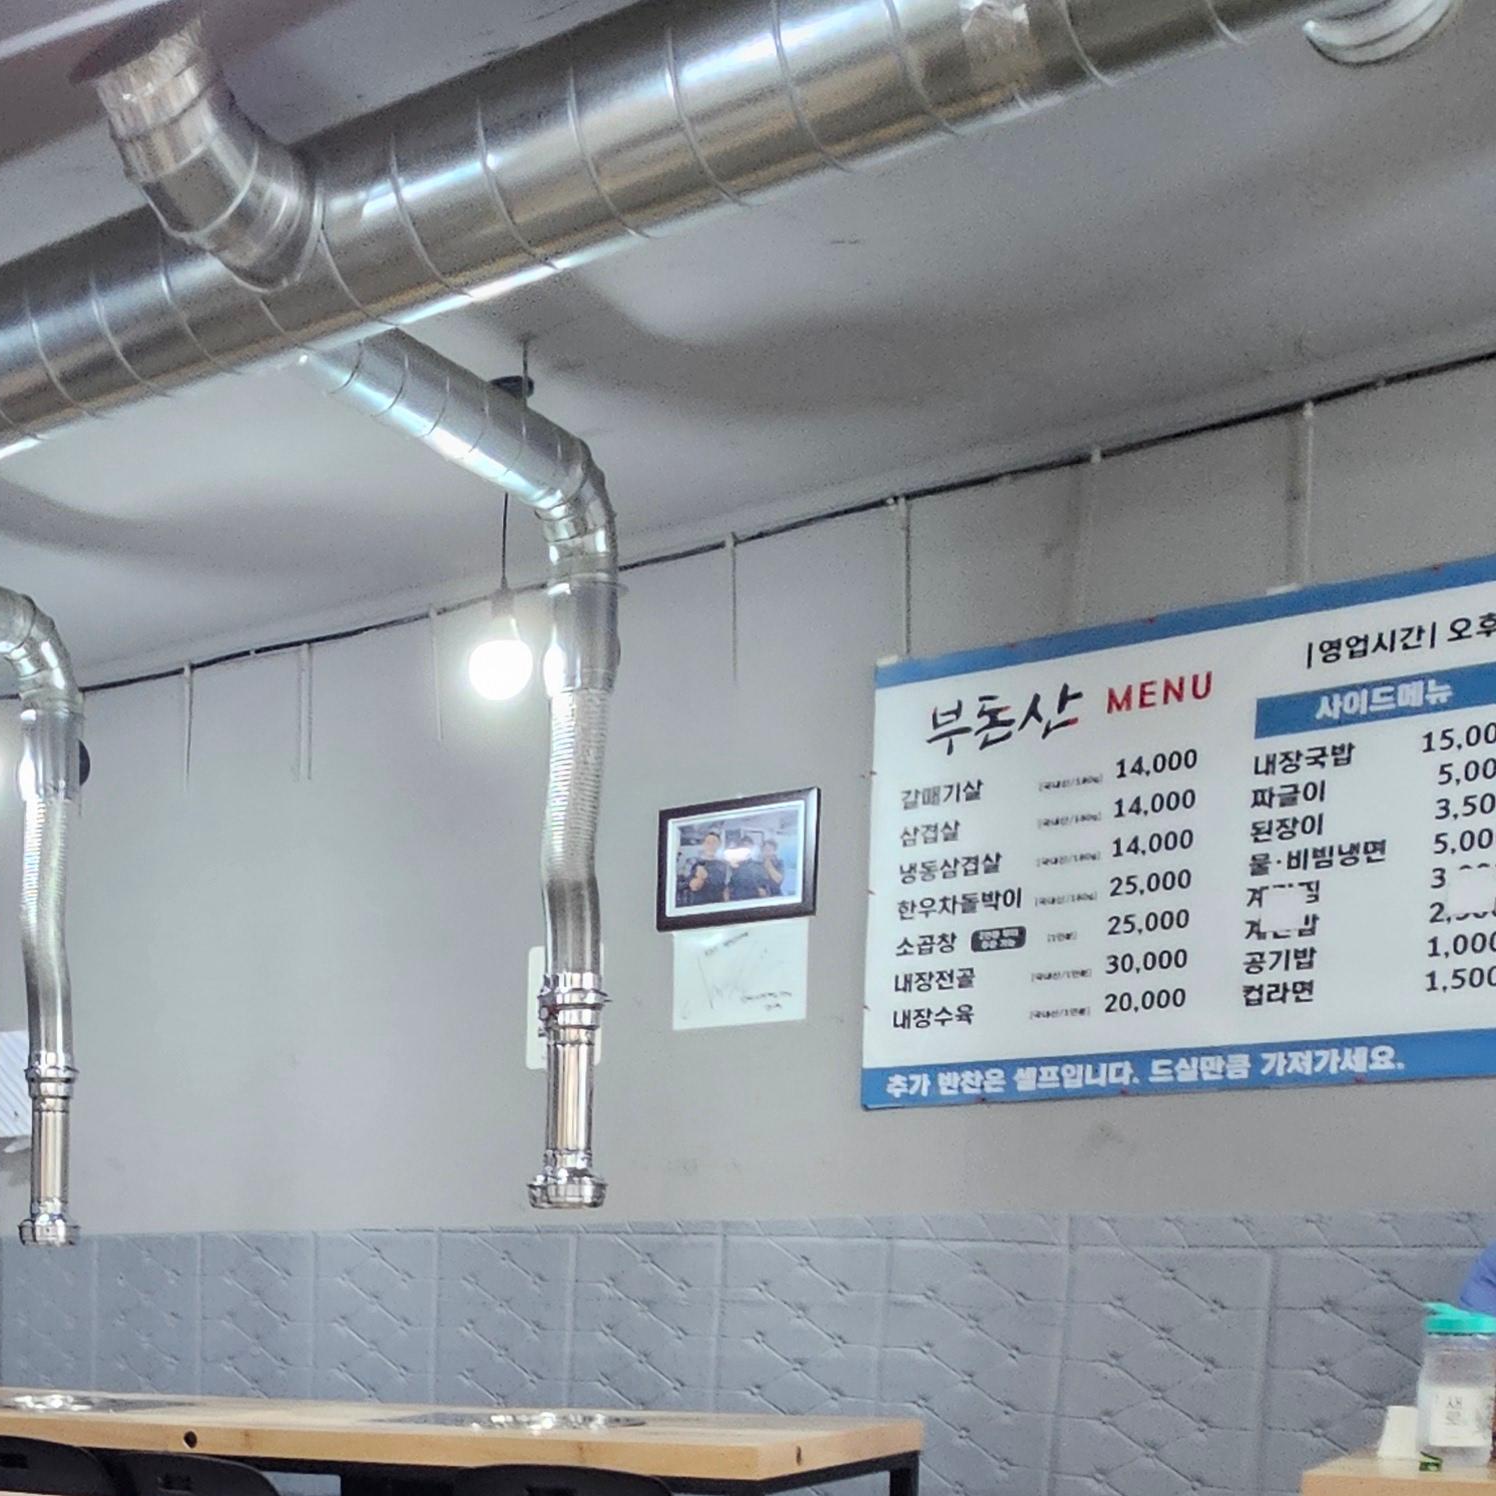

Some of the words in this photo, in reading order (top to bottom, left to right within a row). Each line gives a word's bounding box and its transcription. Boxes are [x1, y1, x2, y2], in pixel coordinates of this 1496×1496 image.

[1447, 612, 1496, 642] 오후
[1106, 671, 1212, 714] MENU
[1315, 679, 1453, 720] 사이드메뉴
[901, 779, 984, 810] 갈매기살
[1116, 749, 1198, 779] 14,000
[1254, 742, 1355, 776] 내장국밥
[1250, 780, 1325, 809] 짜글이
[900, 820, 960, 848] 삼겹살
[1113, 789, 1196, 818] 14,000
[1250, 813, 1324, 843] 된장이
[899, 852, 1002, 884] 냉동삼겹살
[1112, 829, 1194, 858] 14,000
[897, 887, 1022, 921] 한우차돌박이
[1109, 869, 1192, 897] 25,000
[895, 932, 957, 957] 소곱창
[1107, 909, 1190, 936] 25,000
[894, 967, 976, 993] 내장전골
[1105, 949, 1188, 975] 30,000
[1243, 946, 1317, 974] 공기밥
[892, 1003, 975, 1029] 내장수육
[1105, 988, 1186, 1013] 20,000
[1242, 979, 1314, 1007] 컵라면
[886, 1073, 931, 1098] 추가
[937, 1068, 1006, 1095] 반찬은
[1148, 1053, 1251, 1083] 드실만큼
